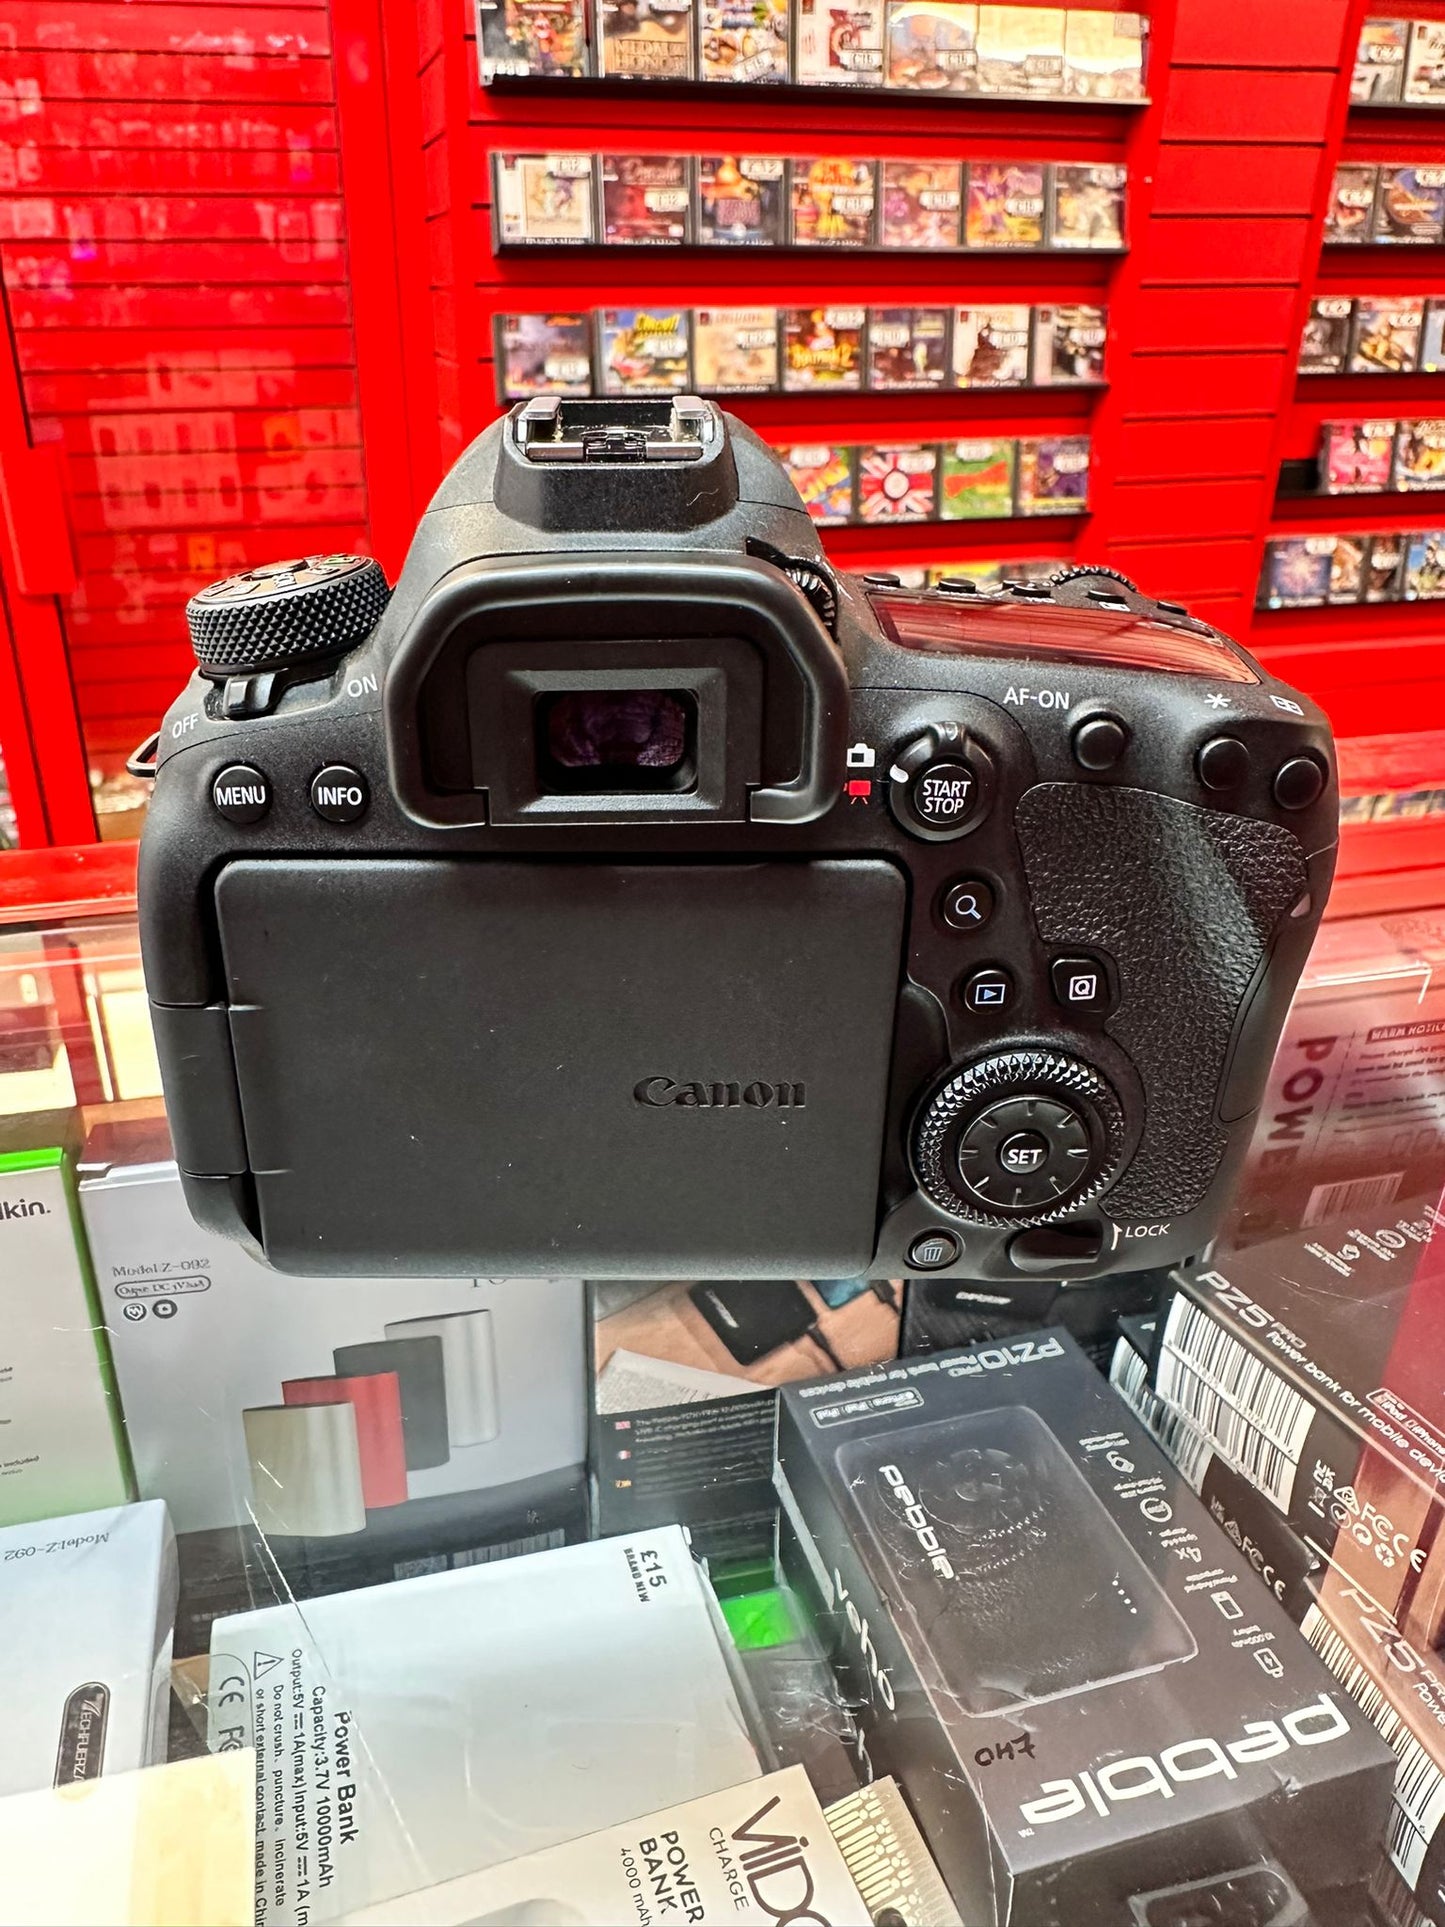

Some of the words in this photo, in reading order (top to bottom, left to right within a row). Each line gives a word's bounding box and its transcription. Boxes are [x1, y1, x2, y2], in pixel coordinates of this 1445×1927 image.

[347, 673, 379, 698] ON
[1003, 686, 1070, 709] AF-ON
[171, 713, 199, 739] OFF
[216, 785, 266, 806] MENU
[317, 786, 363, 806] INFO
[922, 780, 972, 798] START
[923, 797, 965, 815] STOP
[1074, 979, 1091, 996] Q
[632, 1075, 806, 1109] Canon
[1008, 1148, 1042, 1165] SET
[1125, 1222, 1170, 1239] LOCK
[1196, 1270, 1275, 1328] PZ5
[977, 1338, 1065, 1370] PZ10
[1266, 1331, 1307, 1364] Power
[1303, 1359, 1342, 1393] bank
[1339, 1390, 1362, 1409] for
[1358, 1405, 1409, 1450] mobile
[879, 1464, 956, 1580] pebble
[640, 1549, 668, 1588] £15
[1339, 1588, 1426, 1673] PZ5
[273, 1684, 284, 1700] Do
[256, 1702, 266, 1732] short
[274, 1703, 283, 1721] not
[310, 1685, 330, 1790] Capacity:3.7V
[334, 1710, 351, 1778] Power
[1019, 1693, 1351, 1825] pebble
[337, 1784, 356, 1845] Bank
[316, 1796, 334, 1888] 10000mAh
[620, 1848, 641, 1889] 4000
[639, 1838, 678, 1914] BANK
[660, 1830, 705, 1924] POWER
[709, 1827, 749, 1911] CHARGE
